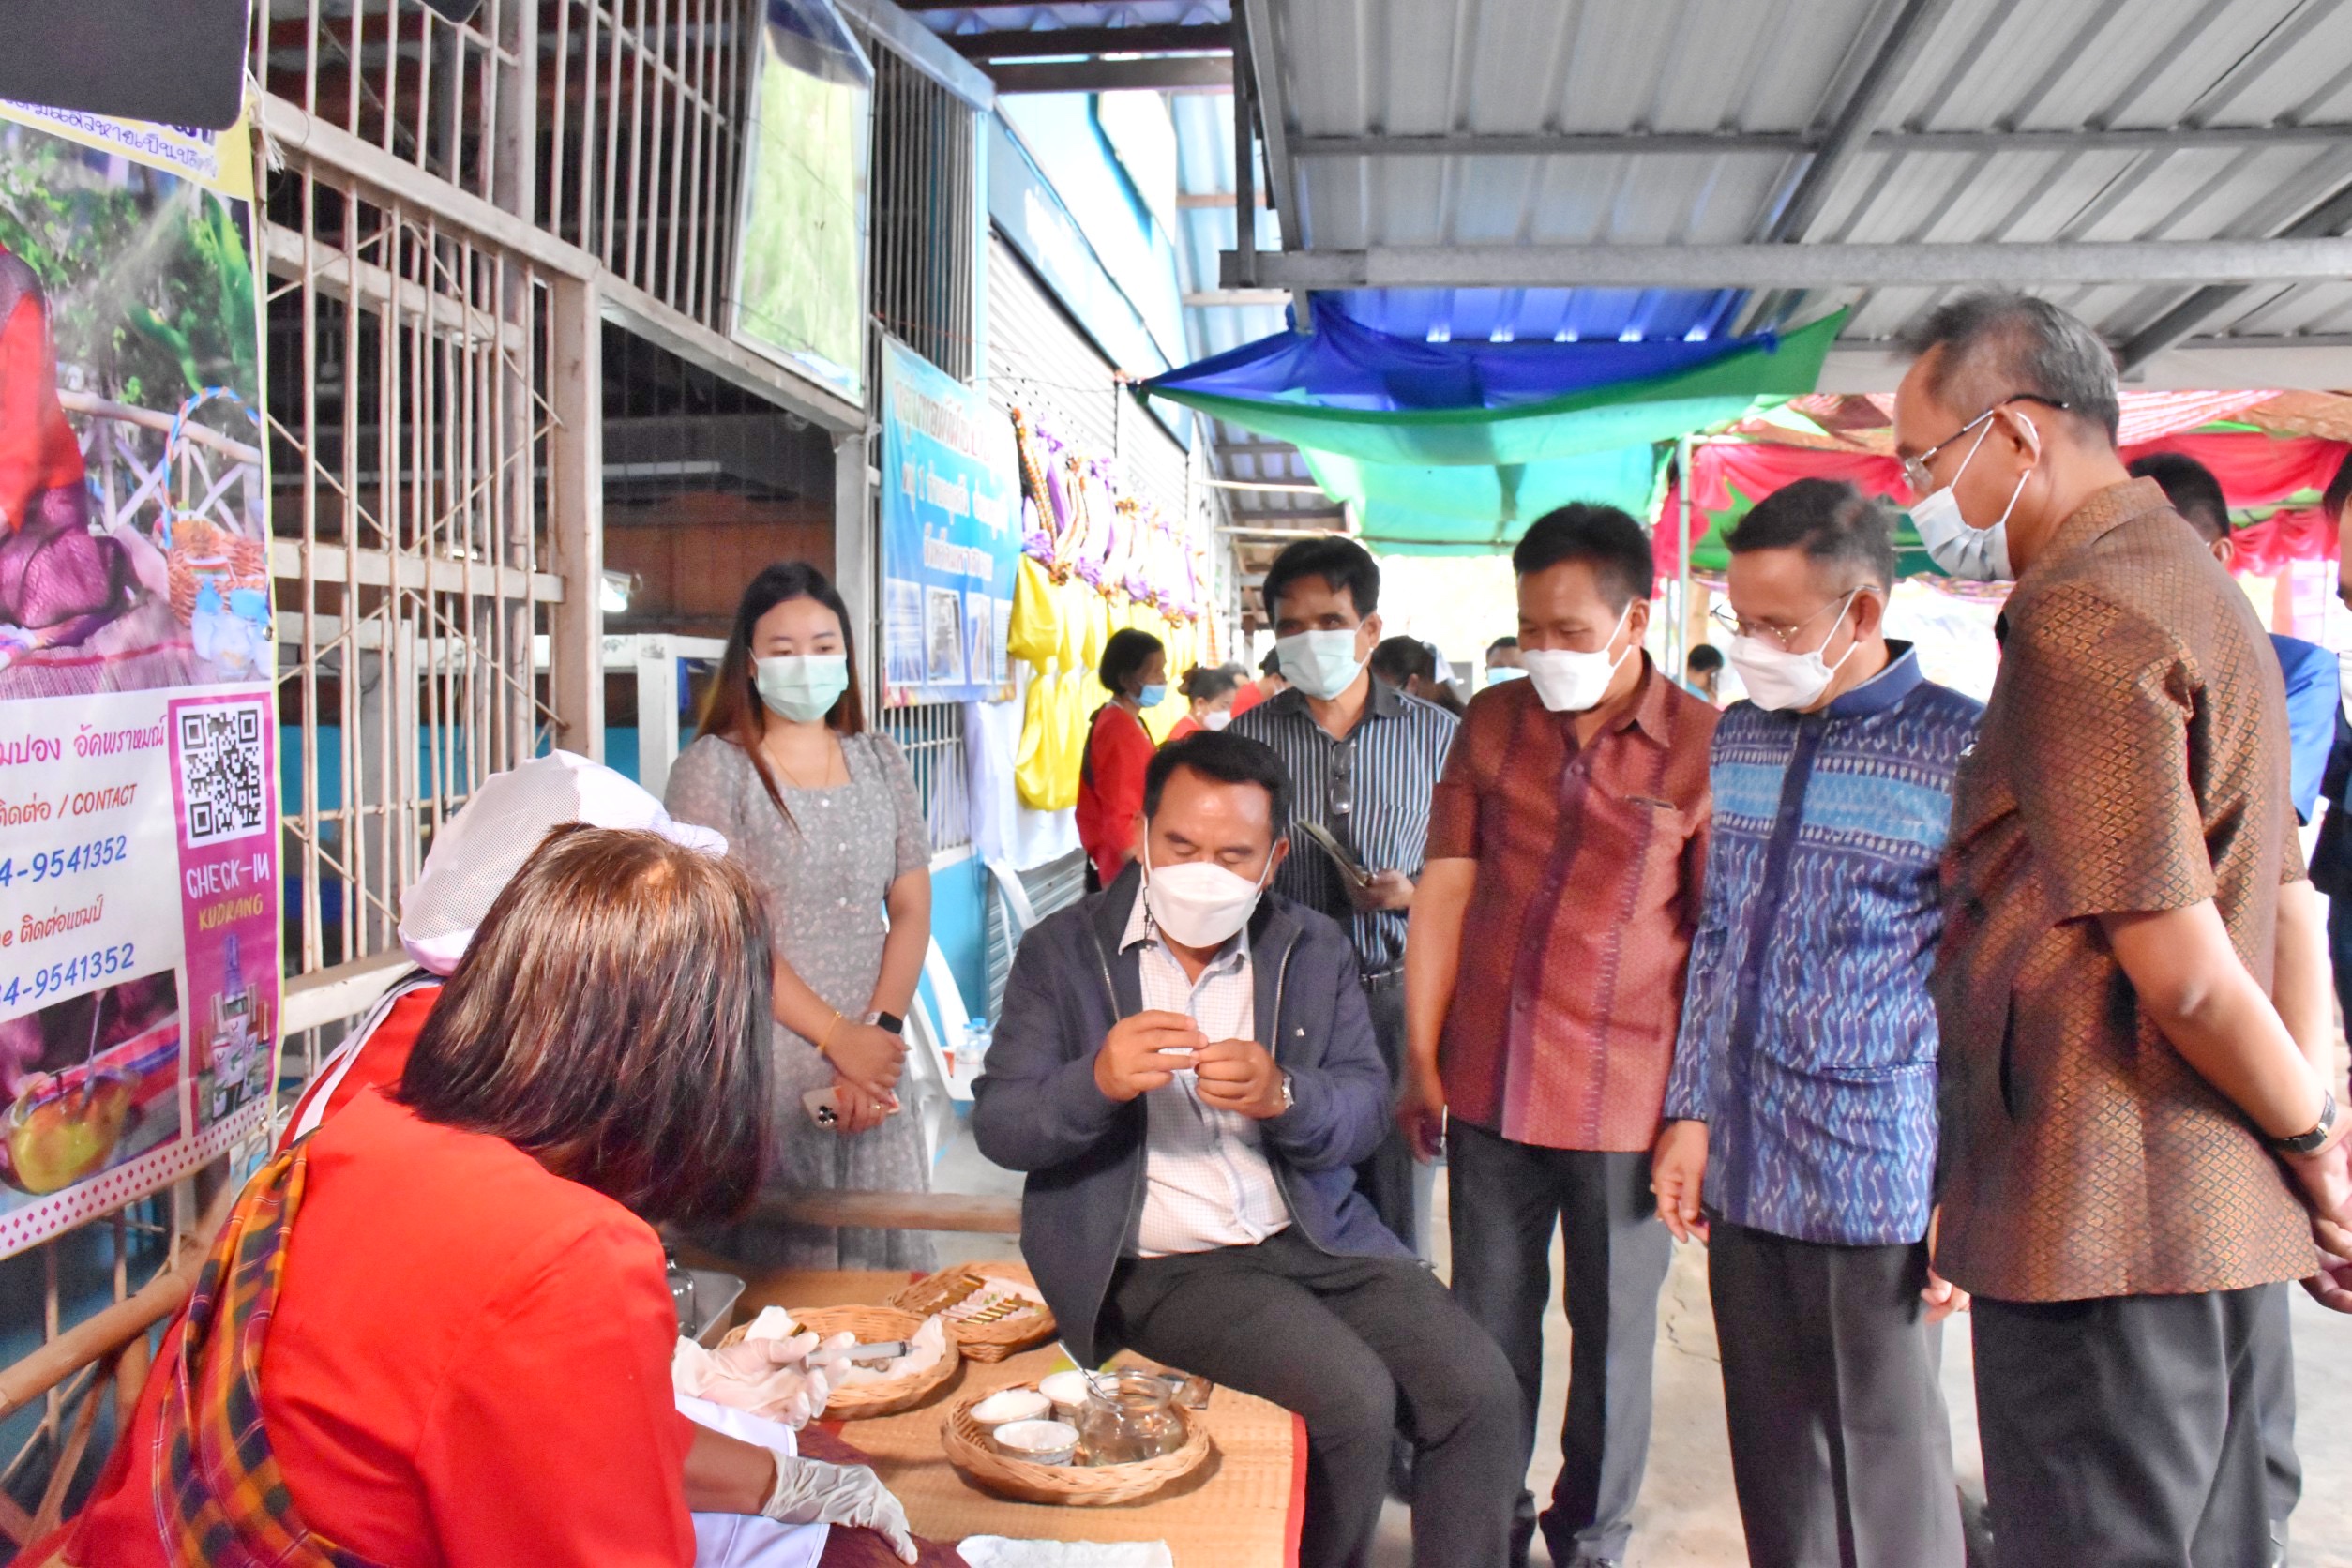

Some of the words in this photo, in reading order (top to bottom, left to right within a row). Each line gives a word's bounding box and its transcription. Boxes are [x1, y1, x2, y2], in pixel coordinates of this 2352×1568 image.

[57, 794, 68, 819] /
[72, 783, 138, 816] CONTACT
[186, 852, 270, 899] CHECK-IN
[20, 893, 104, 943] ติดต่อแชมป์
[199, 892, 263, 932] KUDRANG
[0, 942, 135, 1006] 4-9541352
